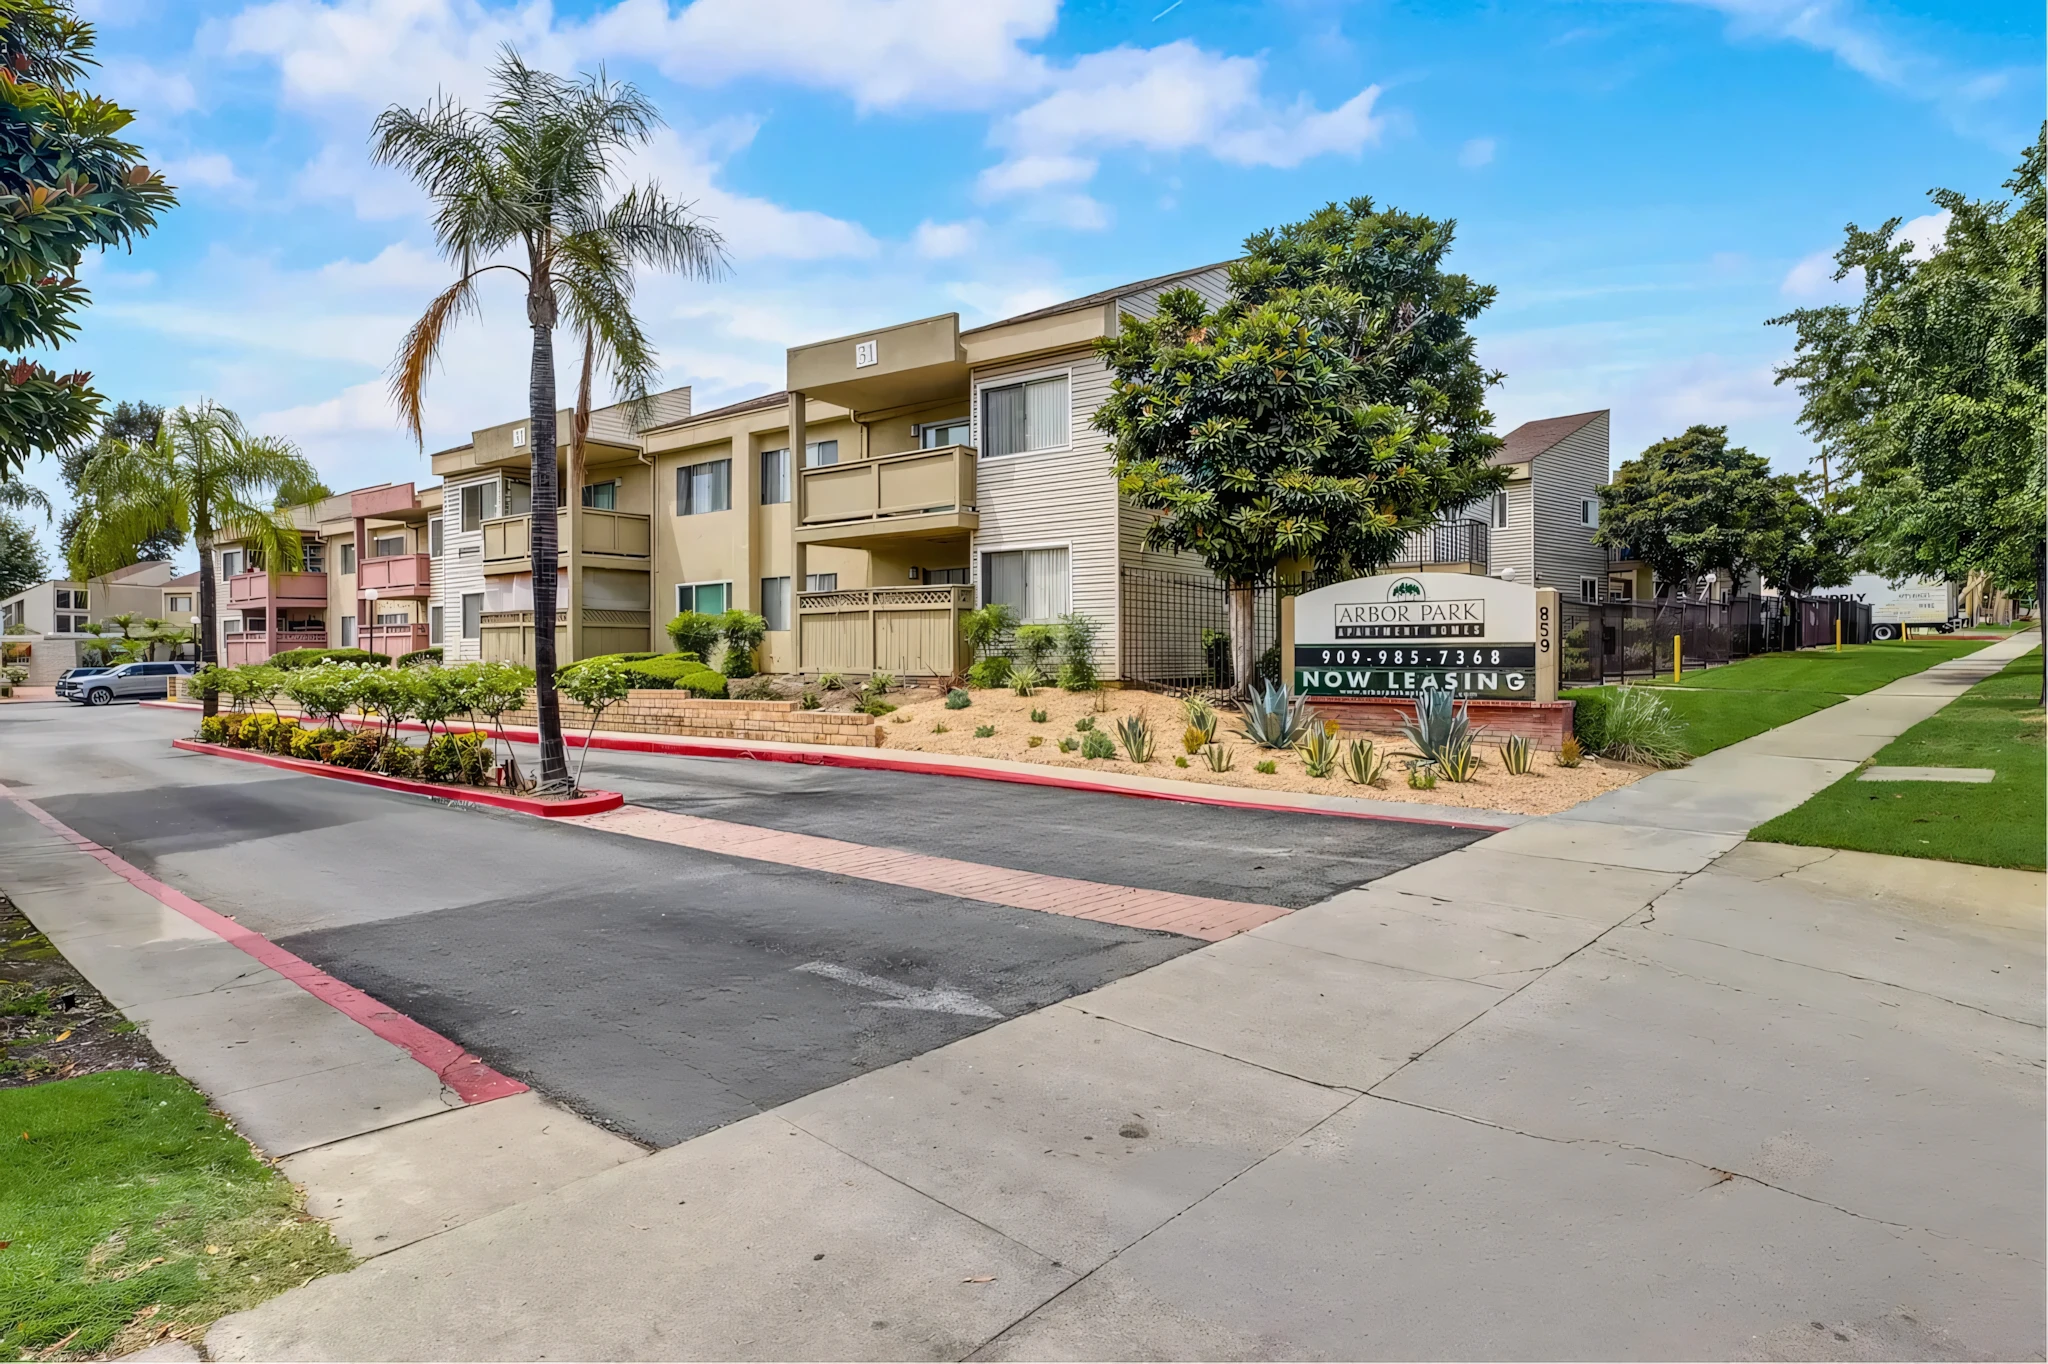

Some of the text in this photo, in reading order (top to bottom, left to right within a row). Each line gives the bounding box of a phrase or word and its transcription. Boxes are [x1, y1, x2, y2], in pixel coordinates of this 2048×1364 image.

[858, 343, 874, 365] 31
[1339, 602, 1480, 623] ARBOR PARK
[1337, 625, 1480, 637] APARTMENT HOMES
[1539, 606, 1550, 653] 859
[1321, 649, 1501, 665] 909-985-7368
[1302, 671, 1526, 692] NOW LEASING
